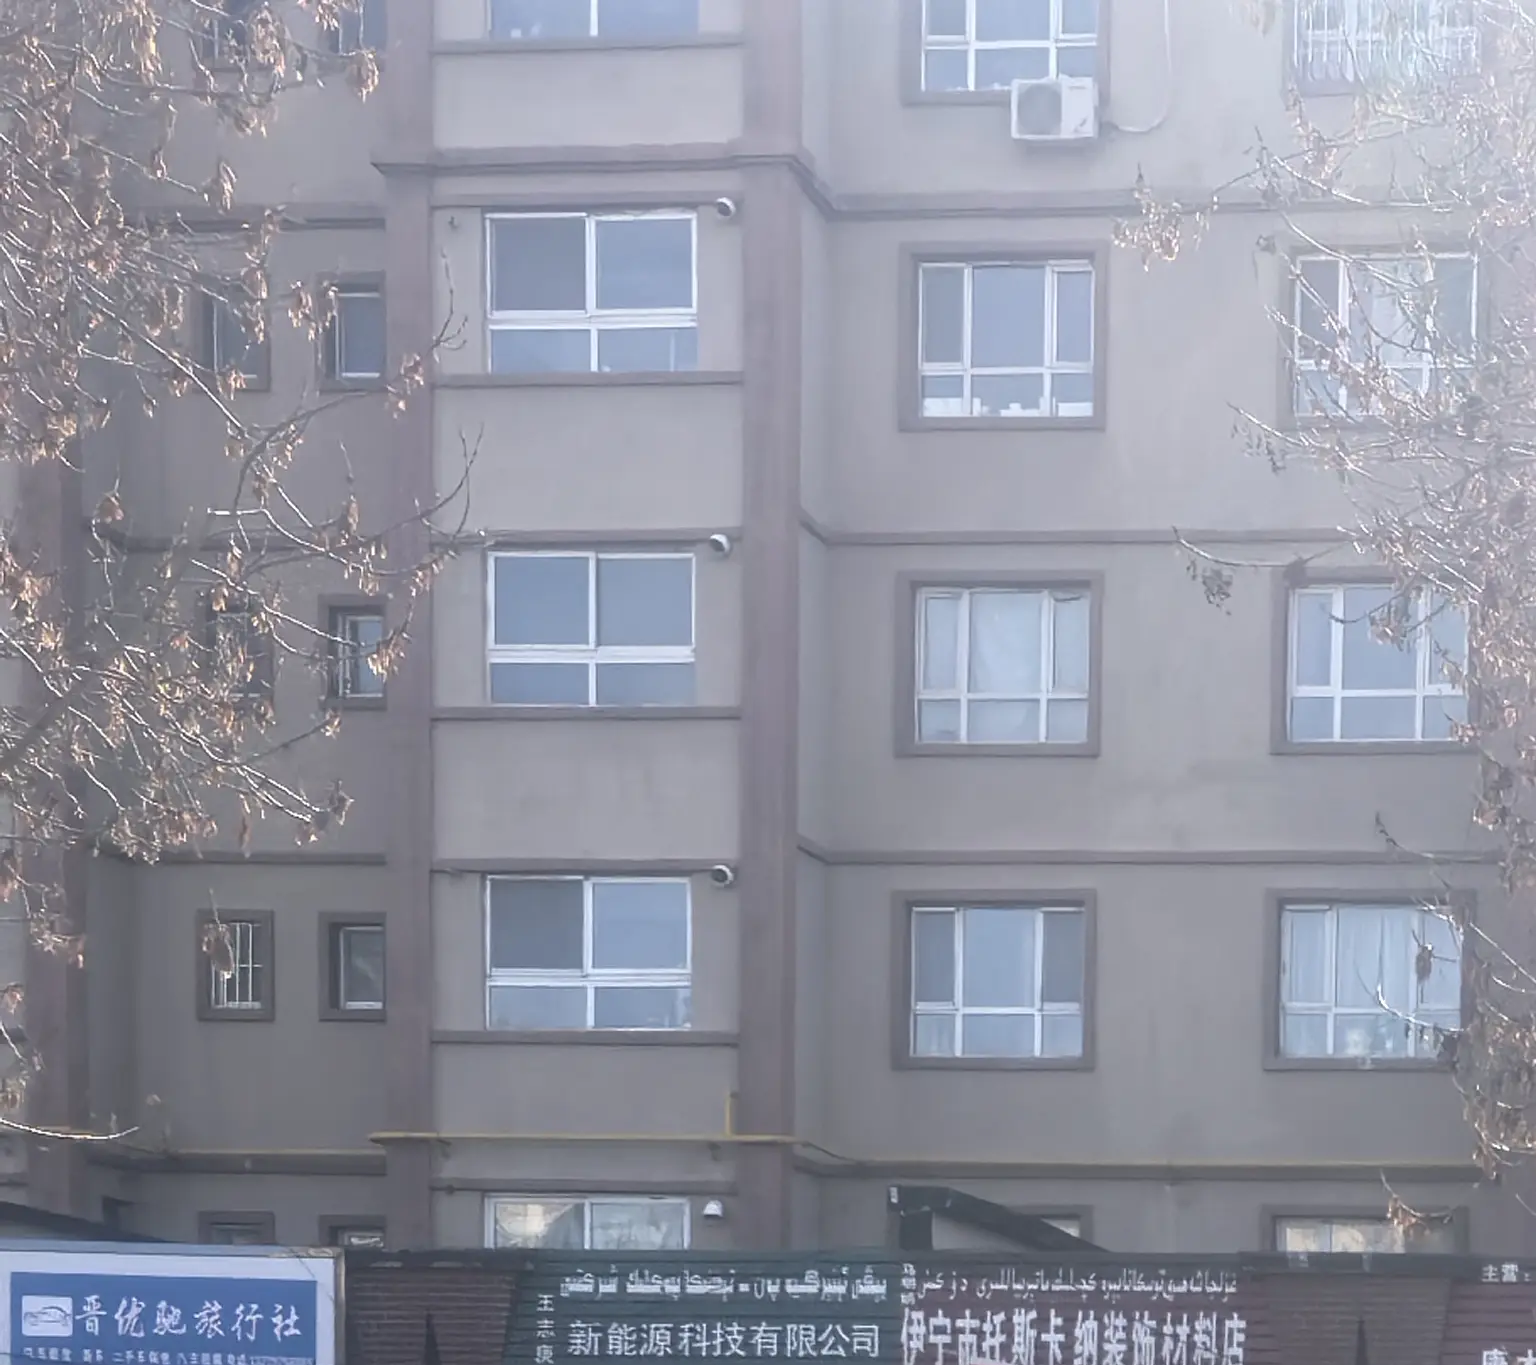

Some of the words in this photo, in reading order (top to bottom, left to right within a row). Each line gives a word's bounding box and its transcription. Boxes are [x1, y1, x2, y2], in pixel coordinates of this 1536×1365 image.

[74, 1295, 303, 1341] 晋优驰旅行社
[566, 1318, 881, 1359] 新能源科技有限公司
